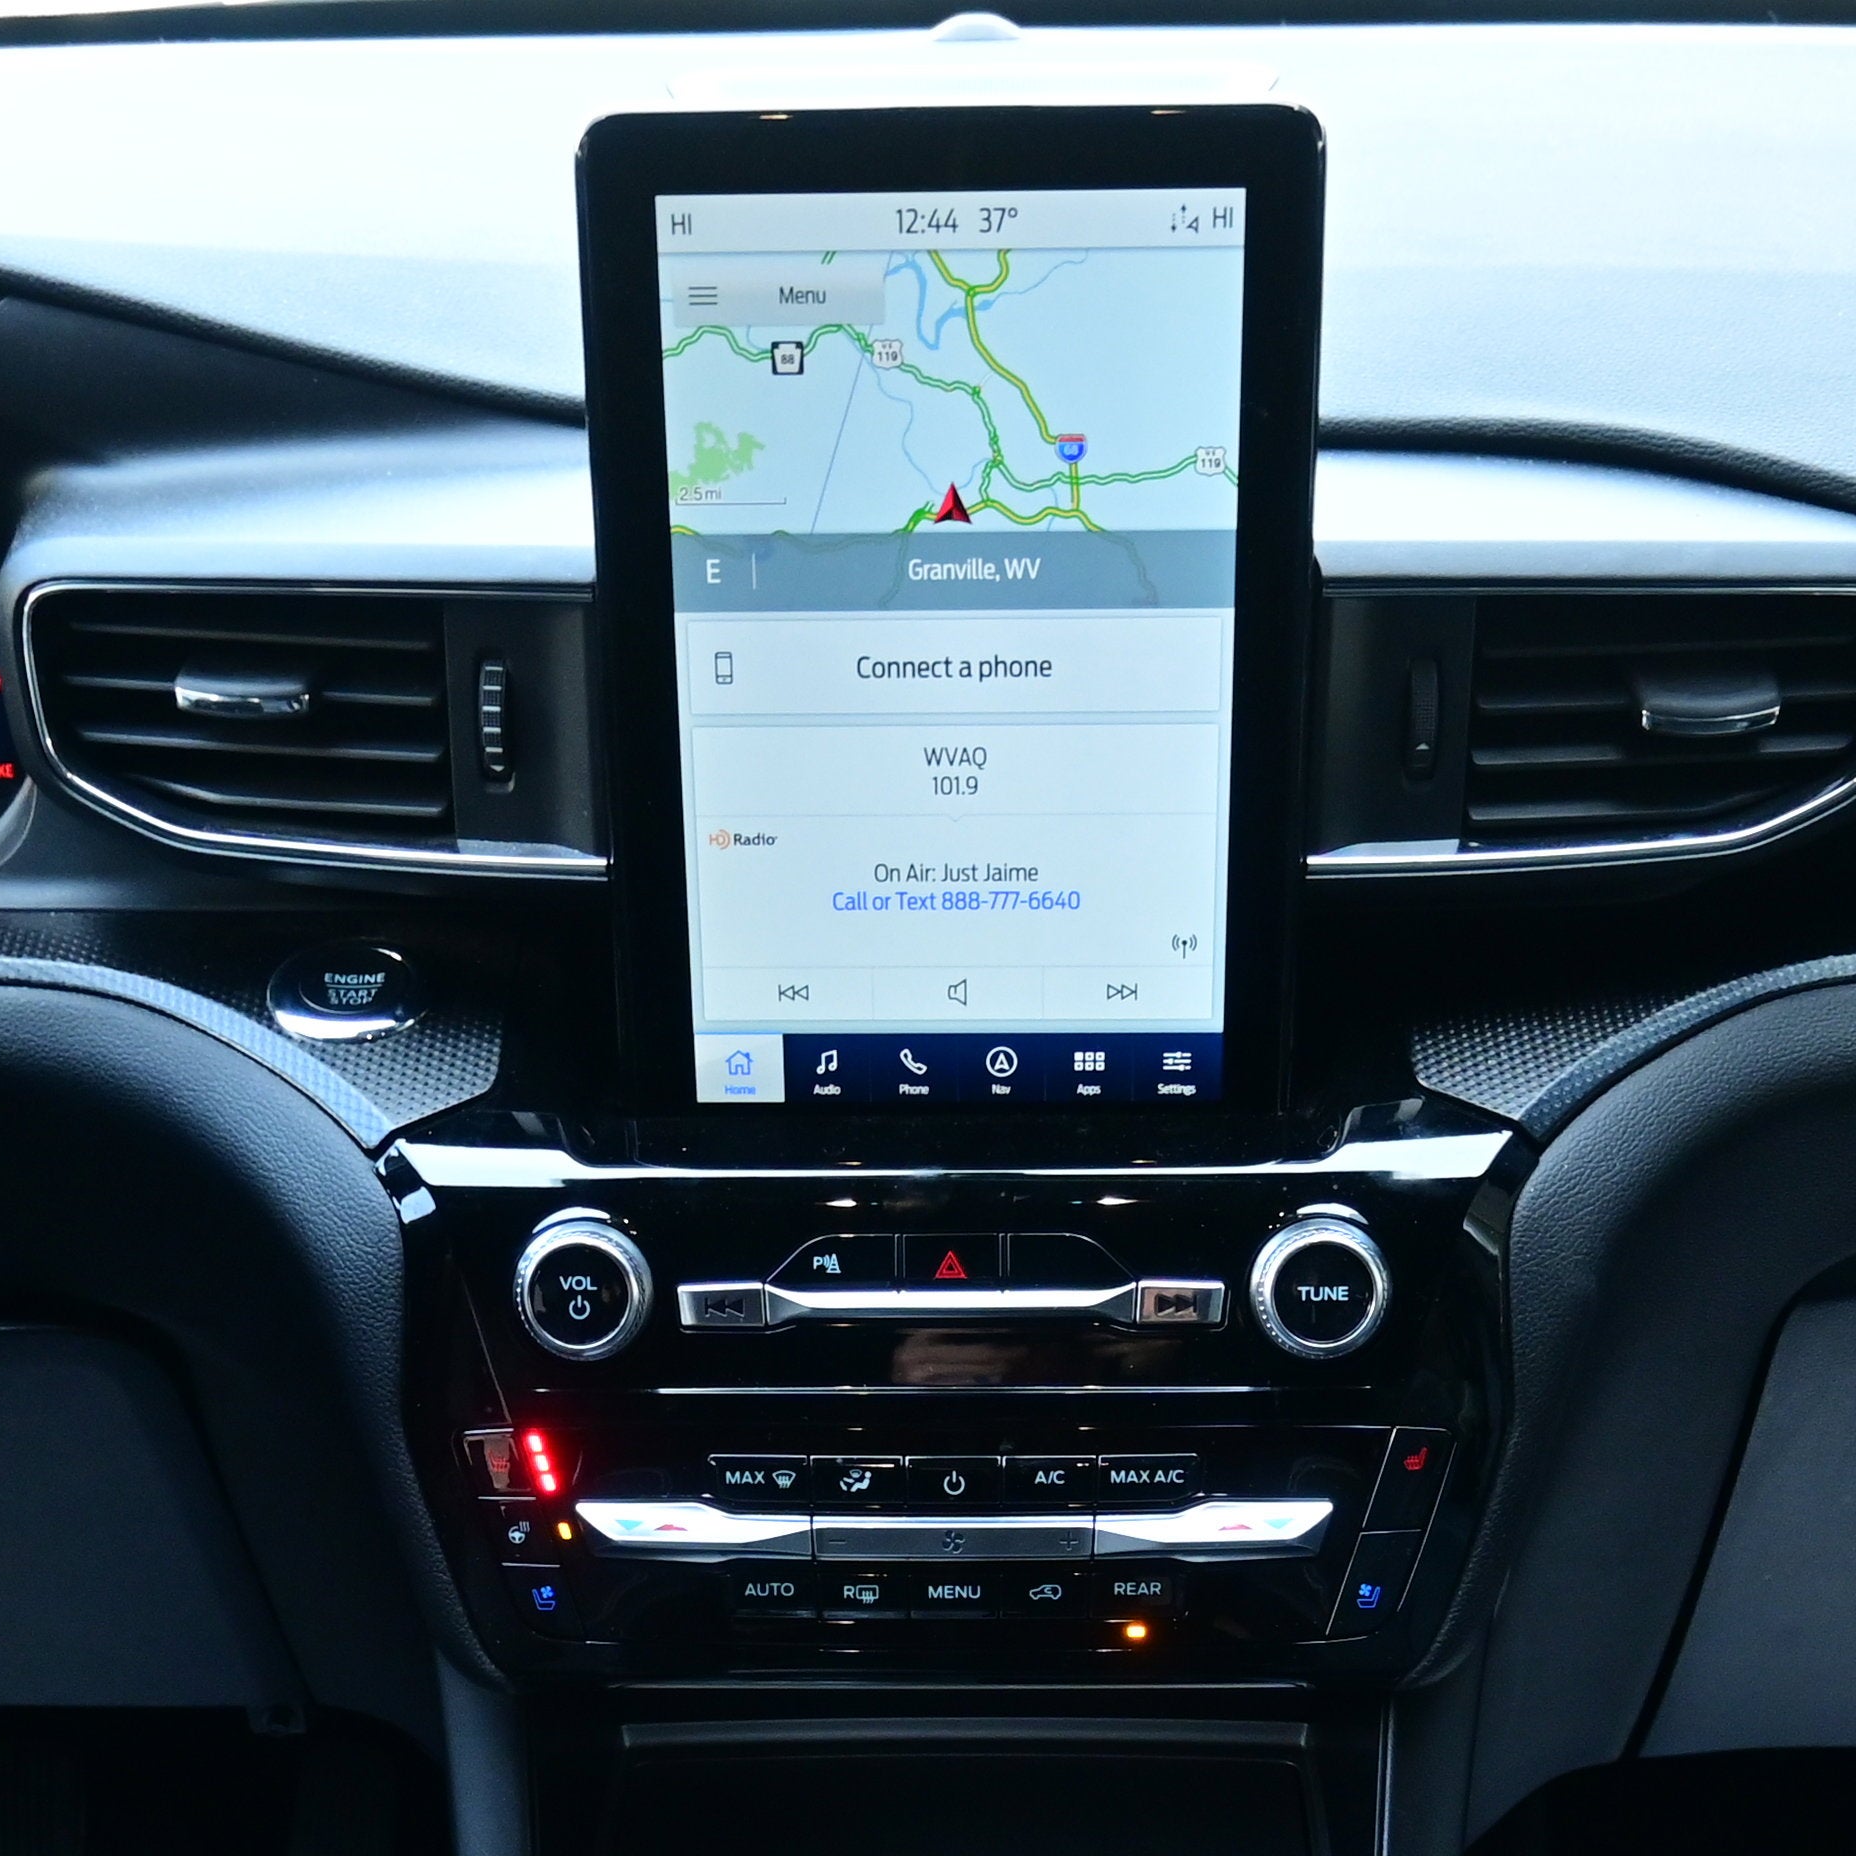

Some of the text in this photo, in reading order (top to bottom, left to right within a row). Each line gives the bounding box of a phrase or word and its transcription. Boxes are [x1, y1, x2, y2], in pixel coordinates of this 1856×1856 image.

[670, 213, 693, 235] HI
[895, 207, 1019, 234] 12:44 37°
[1212, 206, 1234, 229] HI
[778, 286, 827, 304] Menu
[780, 353, 795, 366] 88
[877, 351, 898, 363] 119
[1200, 457, 1221, 469] 119
[706, 559, 721, 584] E
[908, 558, 1041, 582] Granville, WV
[856, 654, 1053, 682] Connect a phone
[923, 746, 988, 770] WVAQ
[931, 775, 979, 796] 101.9
[733, 832, 776, 846] Radio
[873, 862, 1039, 883] On Air: Just Jaime
[832, 890, 1081, 911] Call or Text 888-777-6640
[323, 971, 387, 985] ENGINE
[326, 987, 379, 999] START
[329, 995, 374, 1006] STOP
[724, 1083, 1197, 1097] Home Audio Phone Nav Apps Settings
[559, 1275, 598, 1292] VOL
[1296, 1285, 1350, 1302] TUNE
[725, 1469, 766, 1487] MAX
[1033, 1469, 1066, 1486] A/C
[1109, 1468, 1185, 1485] MAX A/C
[744, 1581, 796, 1598] AUTO
[927, 1584, 982, 1601] MENU
[1112, 1581, 1162, 1597] REAR
